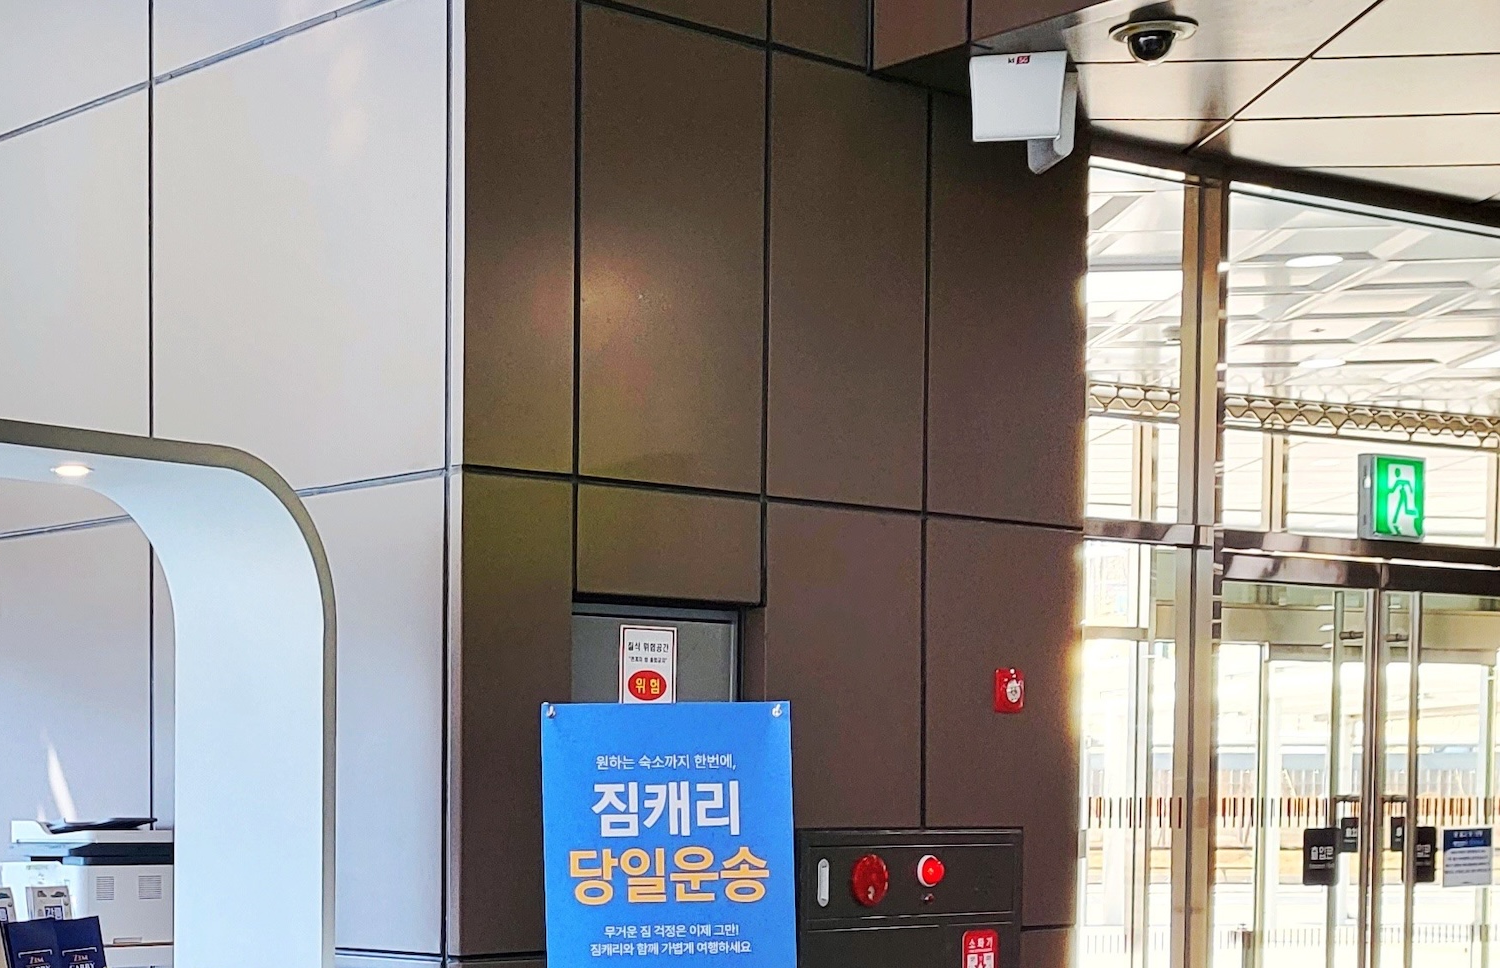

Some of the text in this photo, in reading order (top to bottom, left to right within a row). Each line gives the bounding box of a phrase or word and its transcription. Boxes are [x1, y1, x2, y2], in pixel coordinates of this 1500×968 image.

[635, 677, 660, 695] 위험
[596, 753, 736, 771] 원하는 숙소까지 한번에,
[591, 780, 741, 837] 짐캐리
[568, 846, 770, 905] 당일운송
[604, 923, 739, 938] 무거운 짐 걱정은 이제 그만!
[590, 941, 752, 956] 짐캐리와 함께 가볍게 여행하세요
